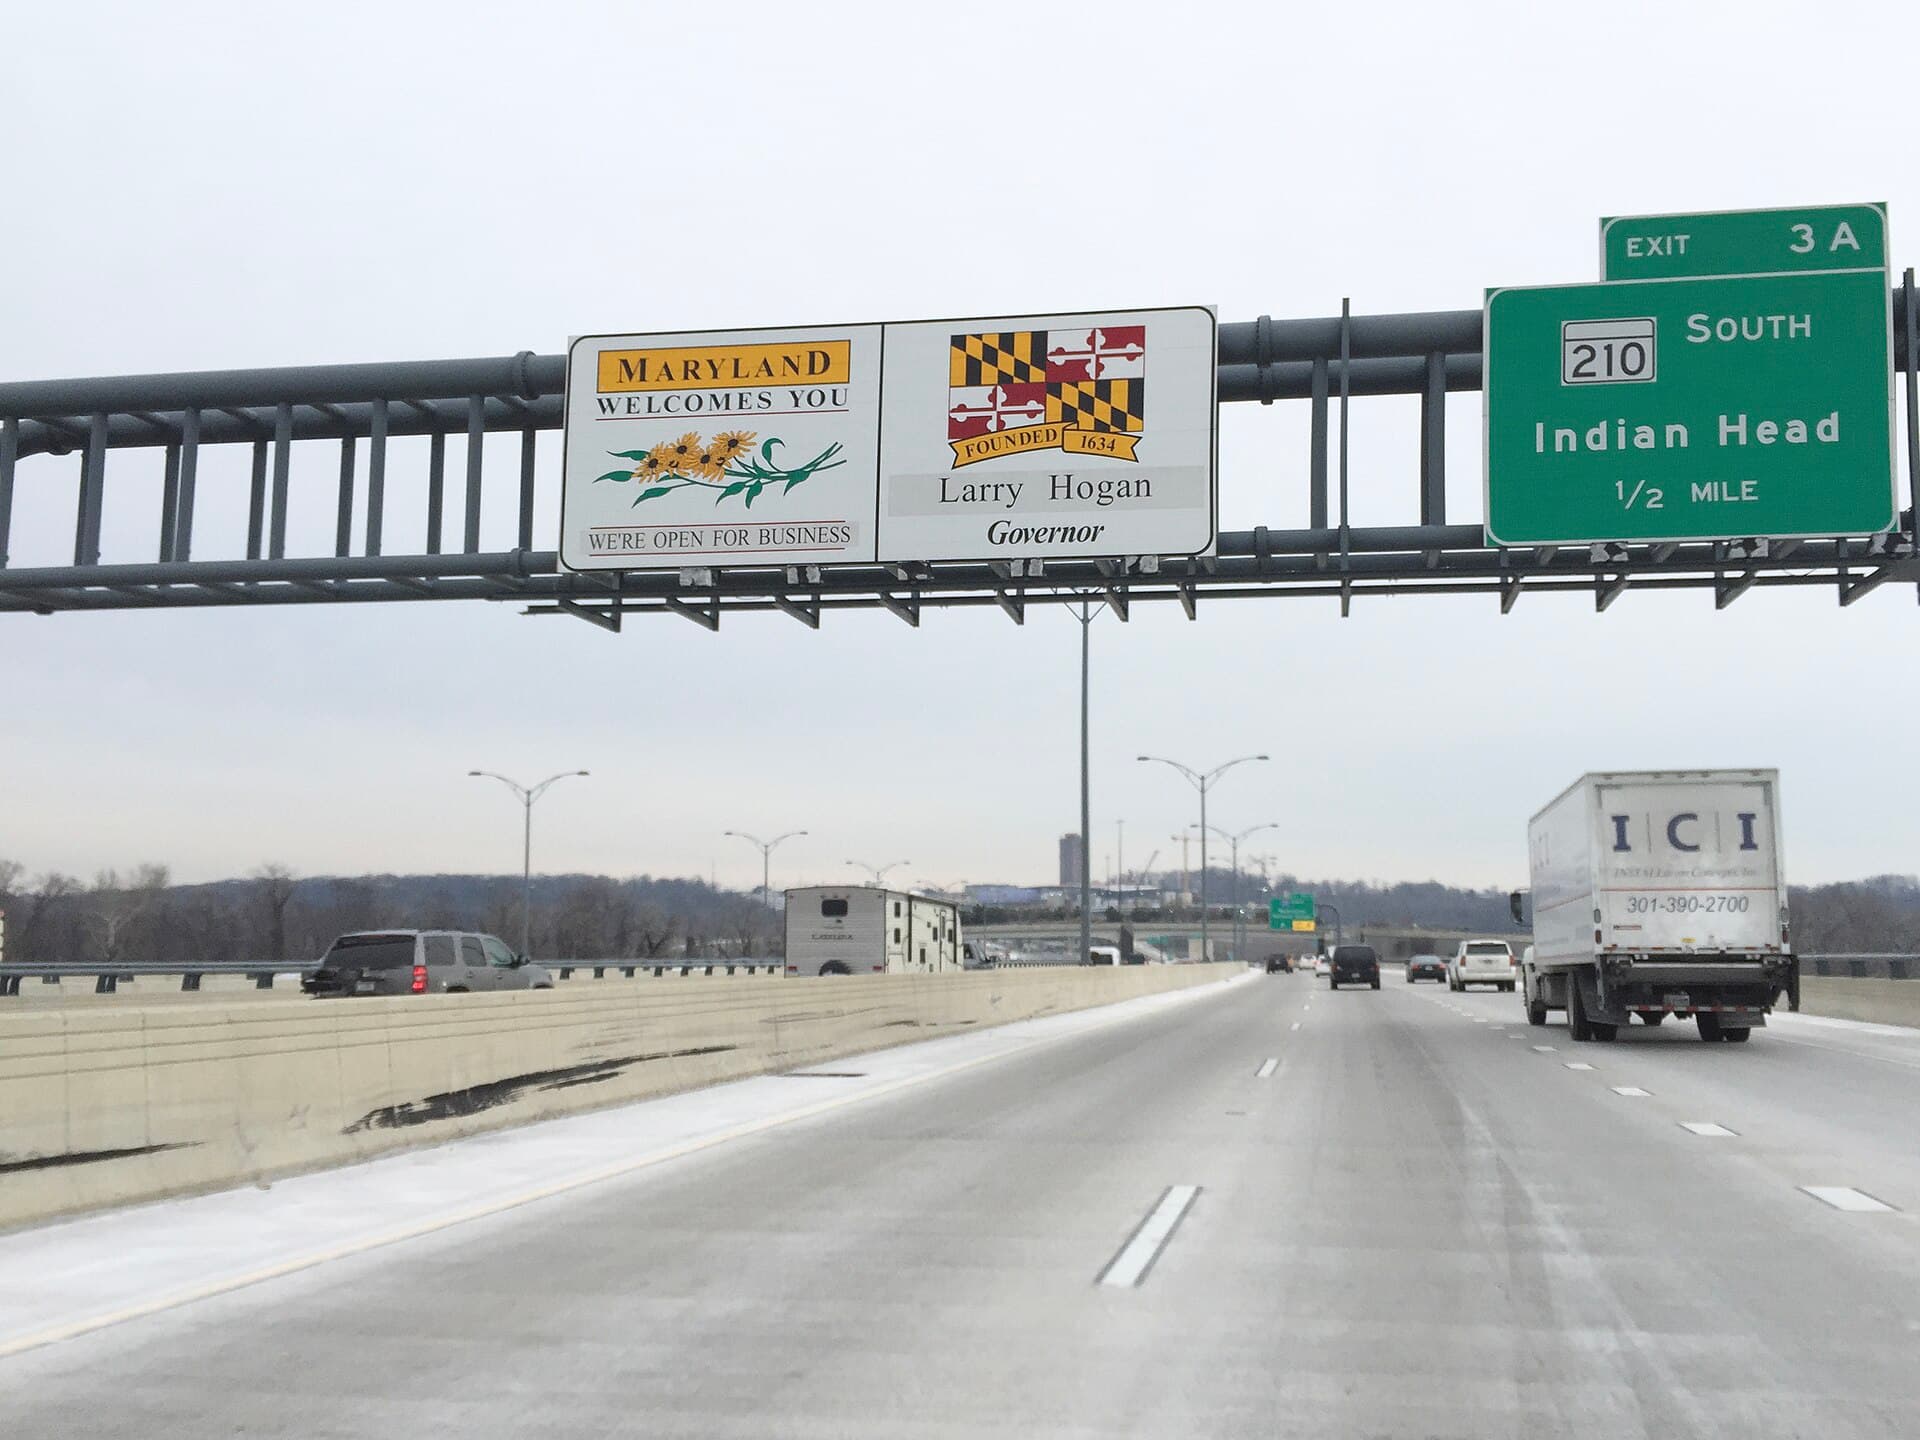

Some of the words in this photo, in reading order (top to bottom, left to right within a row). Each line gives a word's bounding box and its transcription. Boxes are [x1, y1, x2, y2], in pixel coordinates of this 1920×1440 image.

[1626, 235, 1691, 257] EXIT
[1789, 223, 1815, 253] 3
[1829, 222, 1860, 252] A
[1686, 313, 1812, 343] SOUTH
[616, 350, 831, 383] MARYLAND
[1571, 341, 1646, 378] 210
[596, 391, 772, 416] WELCOMES
[788, 388, 848, 408] YOU
[965, 428, 1057, 458] FOUNDED
[1081, 434, 1116, 452] 1634
[1535, 418, 1689, 453] Indian
[1718, 411, 1840, 446] Head
[938, 477, 1023, 509] Larry
[1048, 474, 1152, 506] Hogan
[1615, 479, 1664, 510] 1/2
[1691, 480, 1758, 503] MILE
[588, 532, 646, 550] WE'RE
[653, 530, 704, 548] OPEN
[712, 528, 749, 547] FOR
[759, 525, 851, 546] BUSINESS
[987, 520, 1105, 546] Governor
[1627, 895, 1750, 914] 301-390-2700
